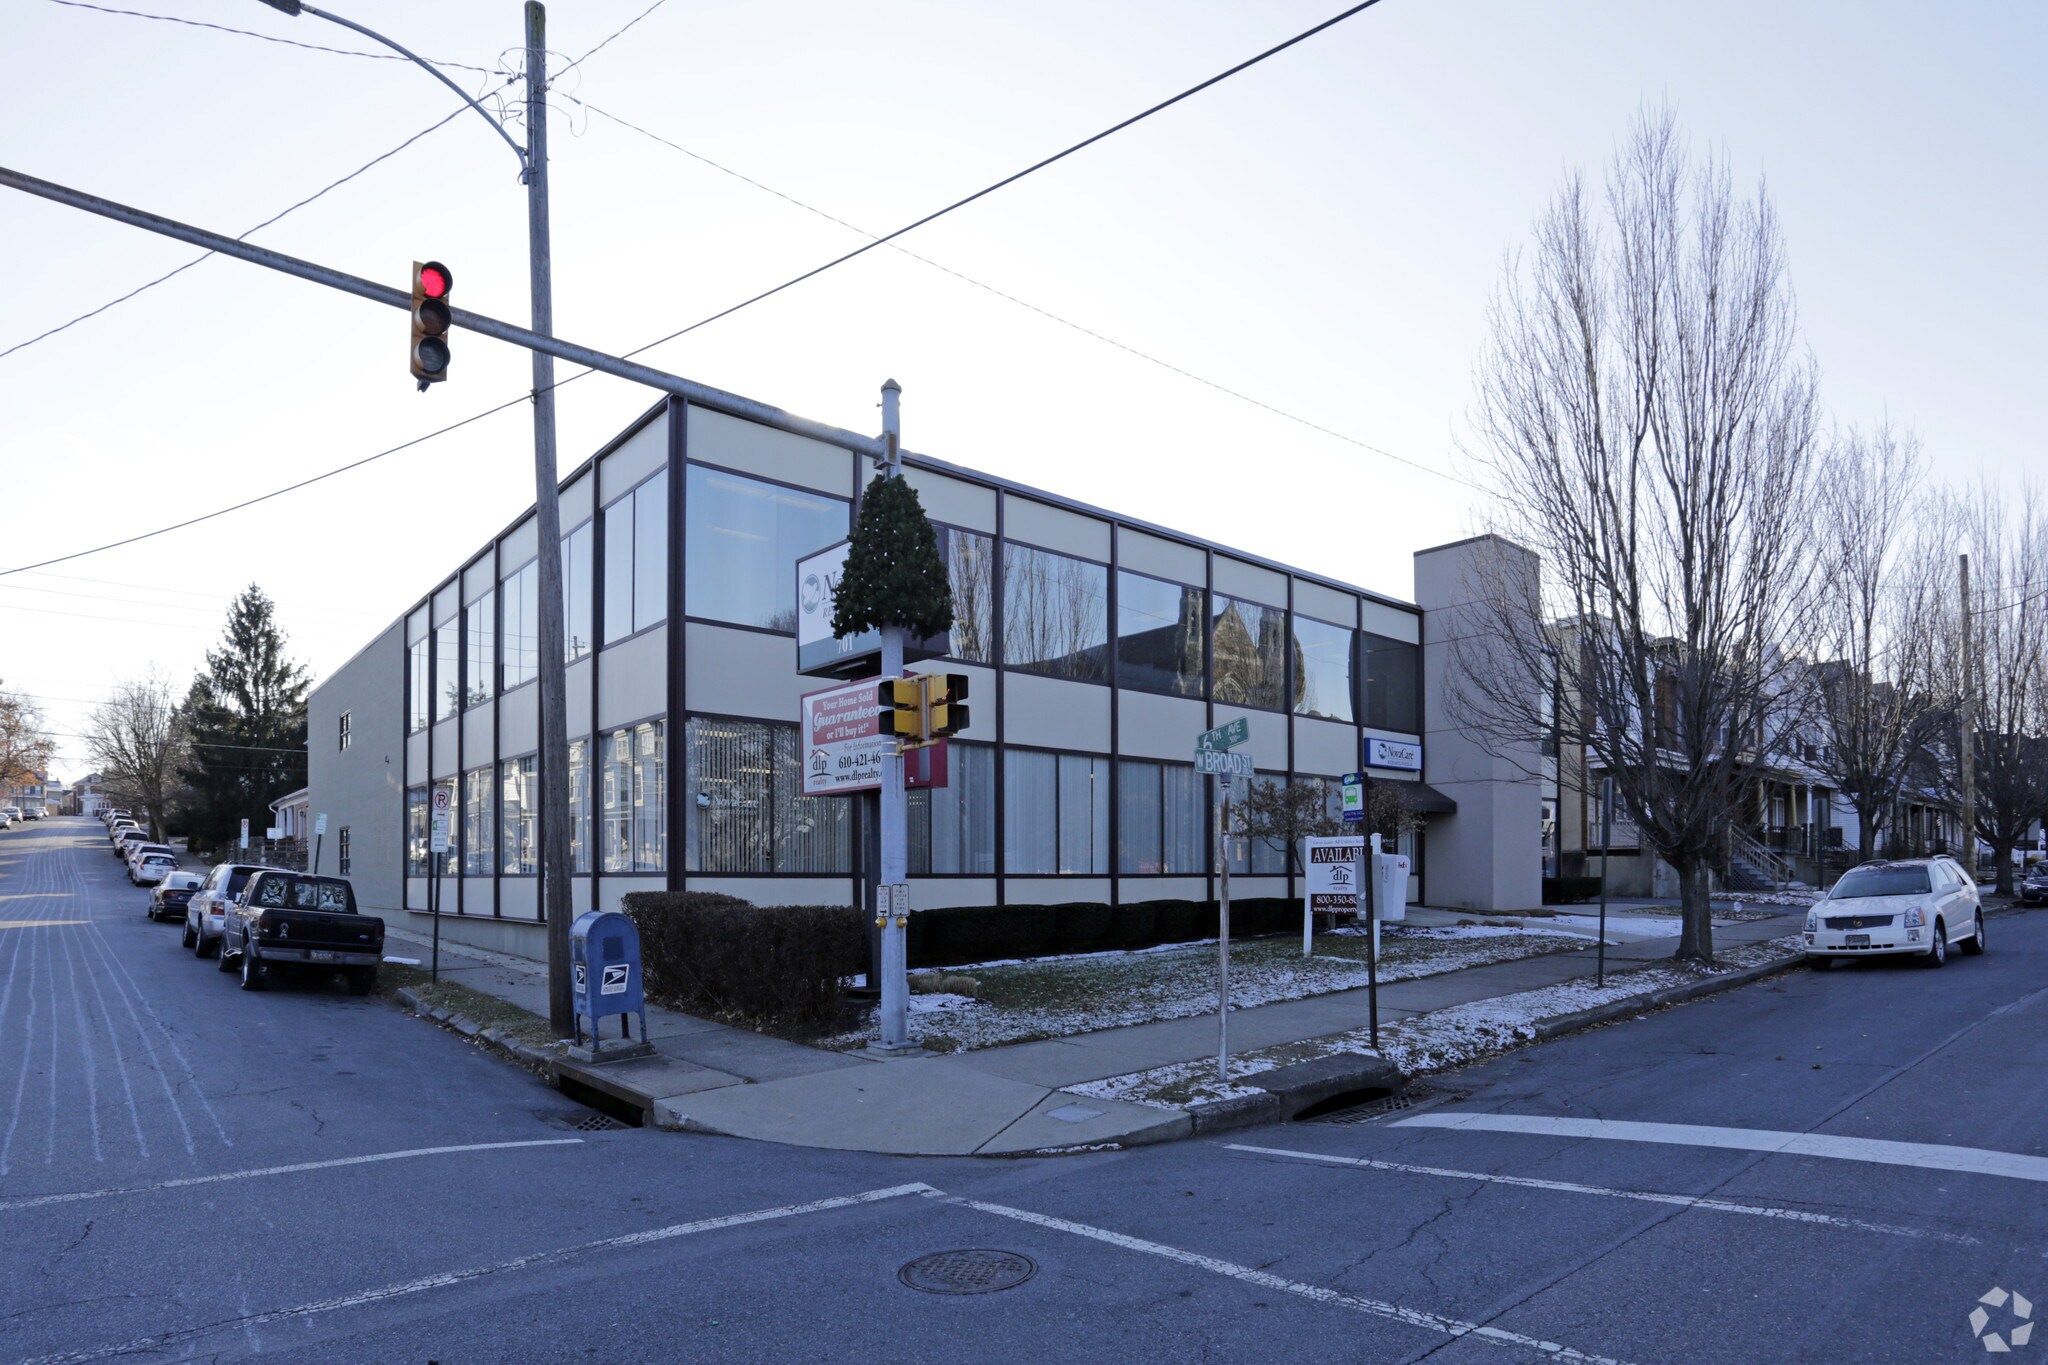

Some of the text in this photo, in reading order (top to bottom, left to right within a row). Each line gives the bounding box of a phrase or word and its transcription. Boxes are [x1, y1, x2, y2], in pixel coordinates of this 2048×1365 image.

[836, 634, 853, 654] 701
[823, 690, 873, 710] Your Home Sold
[826, 731, 833, 739] or
[845, 726, 857, 737] buy
[1228, 721, 1241, 735] AVE
[838, 750, 881, 769] 610-421-46
[1387, 746, 1414, 760] NovaCare
[812, 755, 827, 774] dlp
[1196, 754, 1203, 767] W
[1205, 751, 1241, 774] BROAD
[1242, 755, 1250, 768] ST
[835, 767, 883, 784] www.dlprealty.
[1313, 847, 1364, 862] AVAILAB
[1333, 870, 1349, 884] dlp
[1316, 895, 1357, 904] 800-350-80
